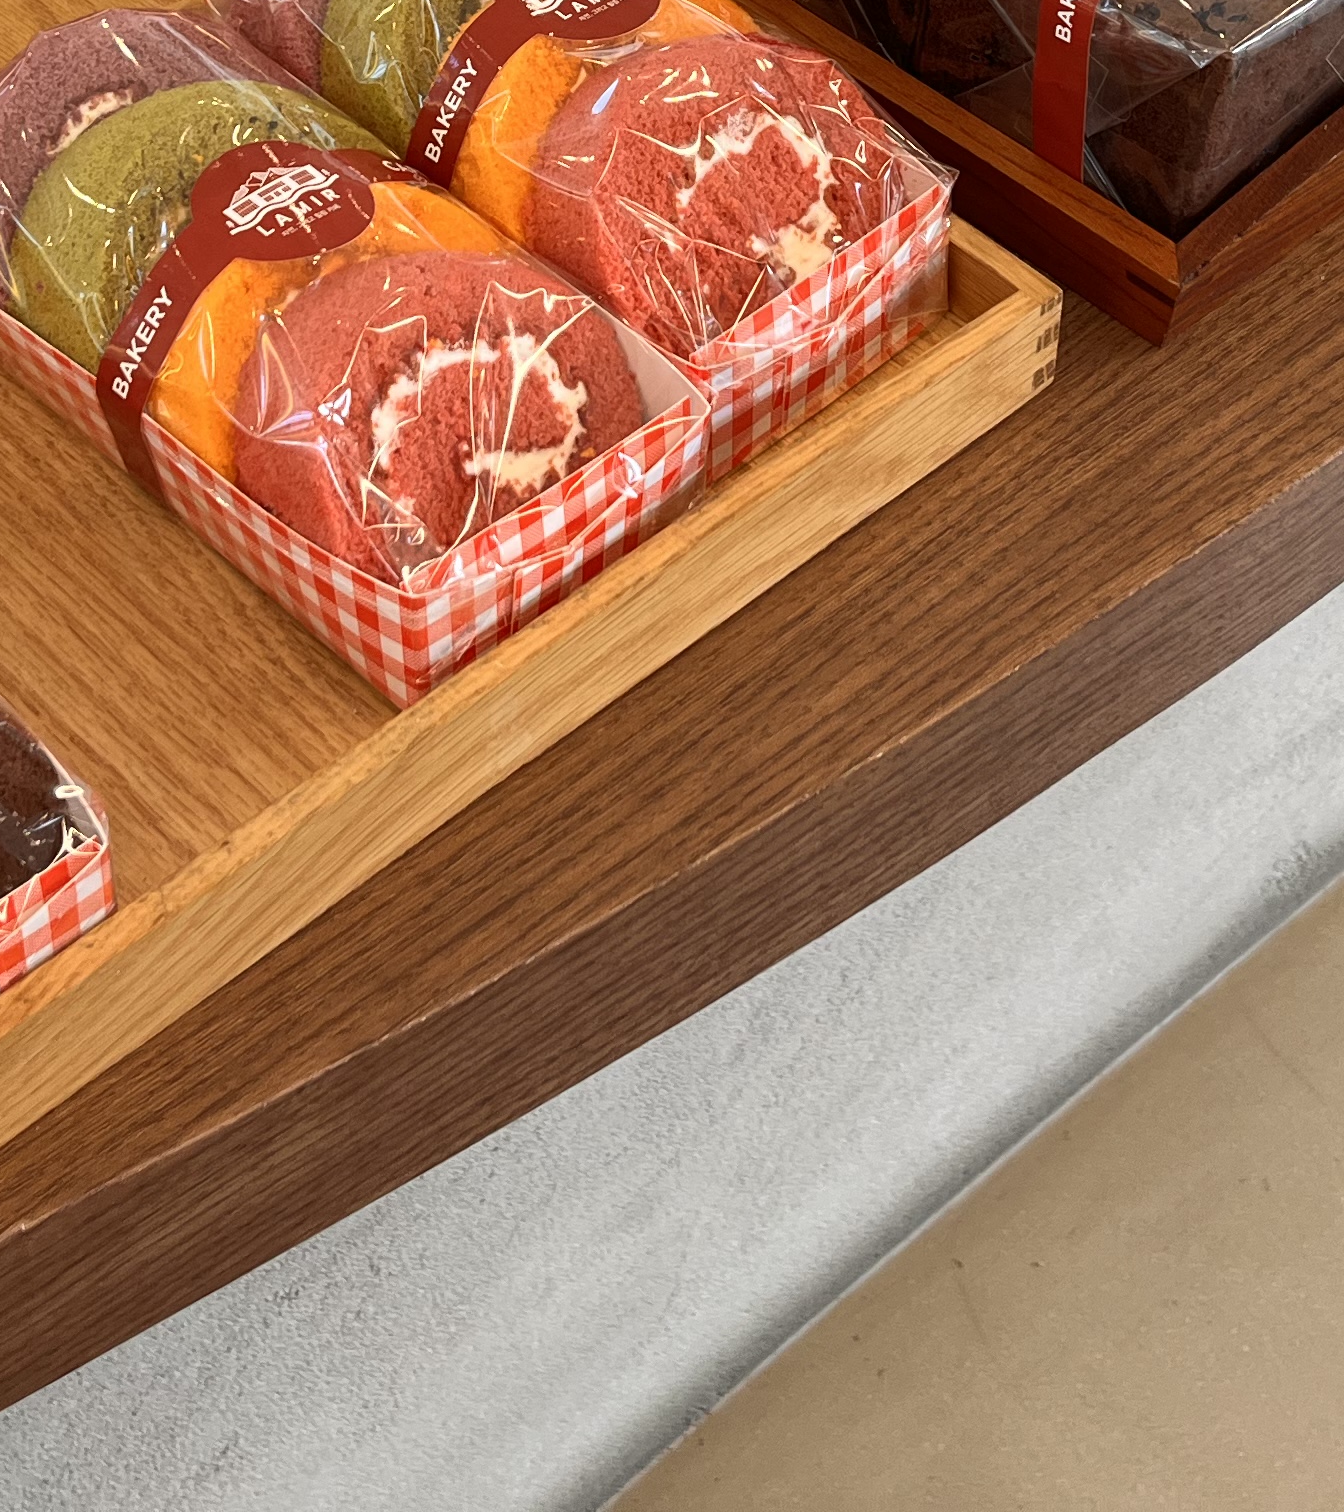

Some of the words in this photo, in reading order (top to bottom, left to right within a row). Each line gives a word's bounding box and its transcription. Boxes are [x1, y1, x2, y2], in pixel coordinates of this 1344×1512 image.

[423, 57, 479, 163] BAKERY
[256, 188, 341, 237] LAMIR
[111, 285, 175, 399] BAKERY
